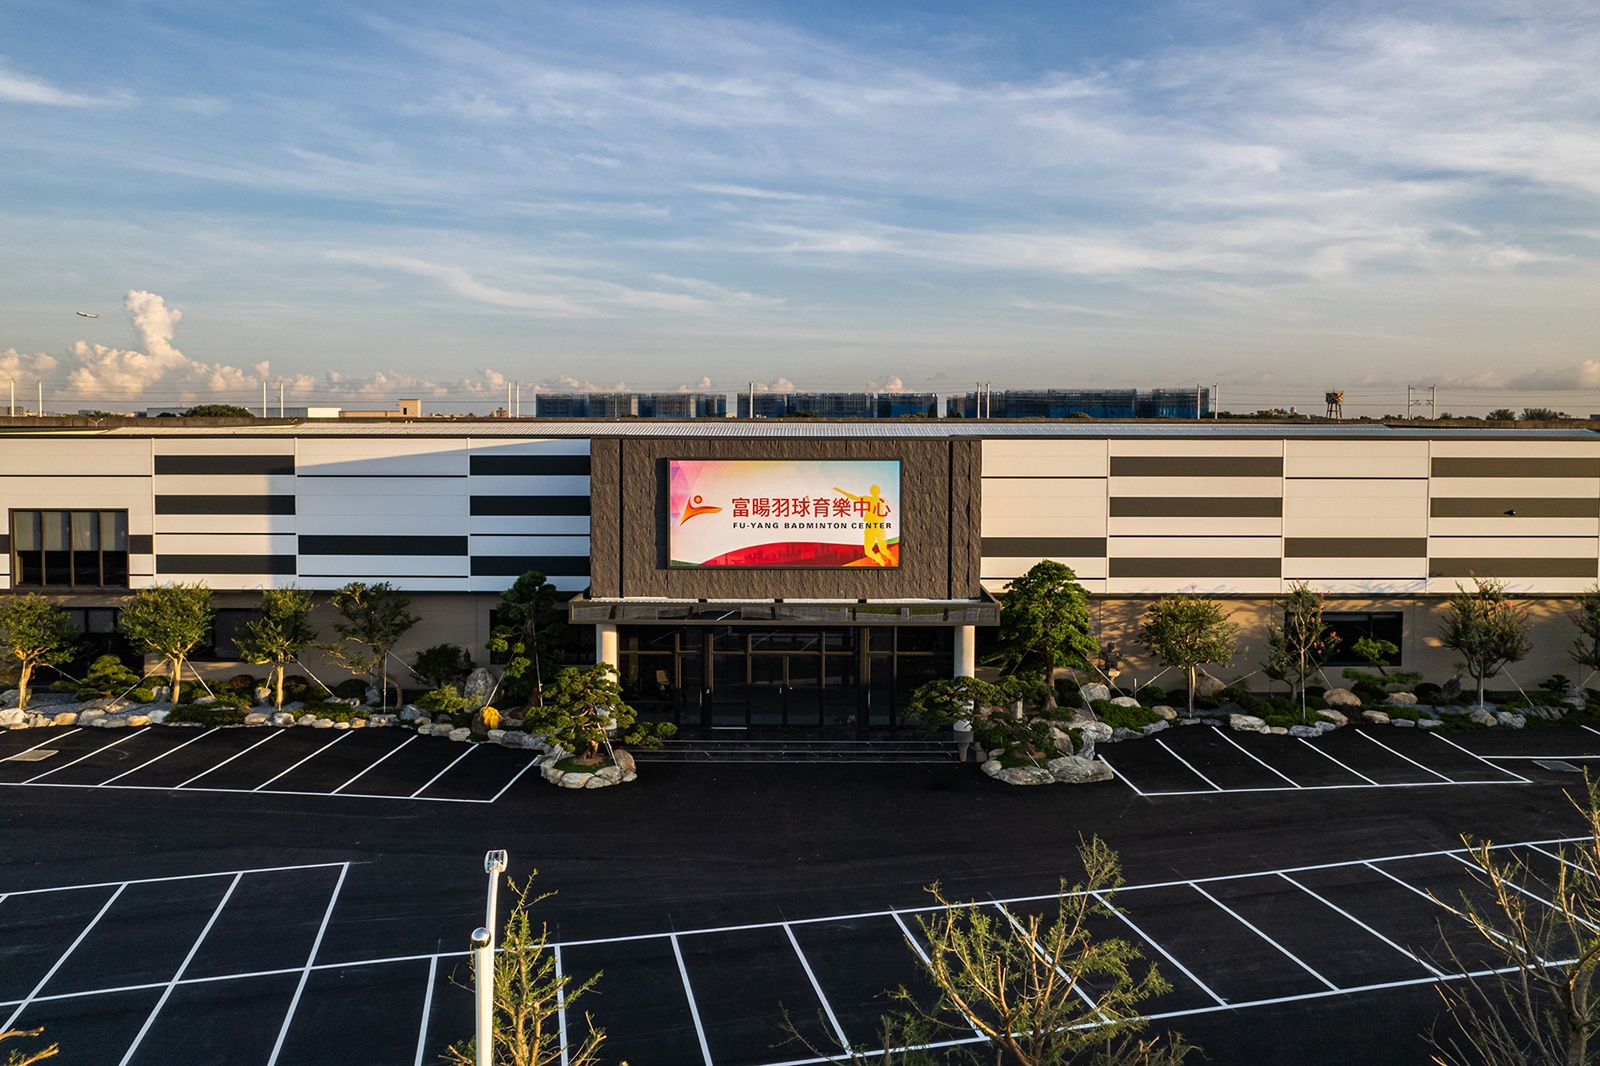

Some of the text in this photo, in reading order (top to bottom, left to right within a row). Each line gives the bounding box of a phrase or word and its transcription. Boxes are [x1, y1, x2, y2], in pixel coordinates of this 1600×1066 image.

[732, 497, 891, 518] 富暘羽球育樂中心
